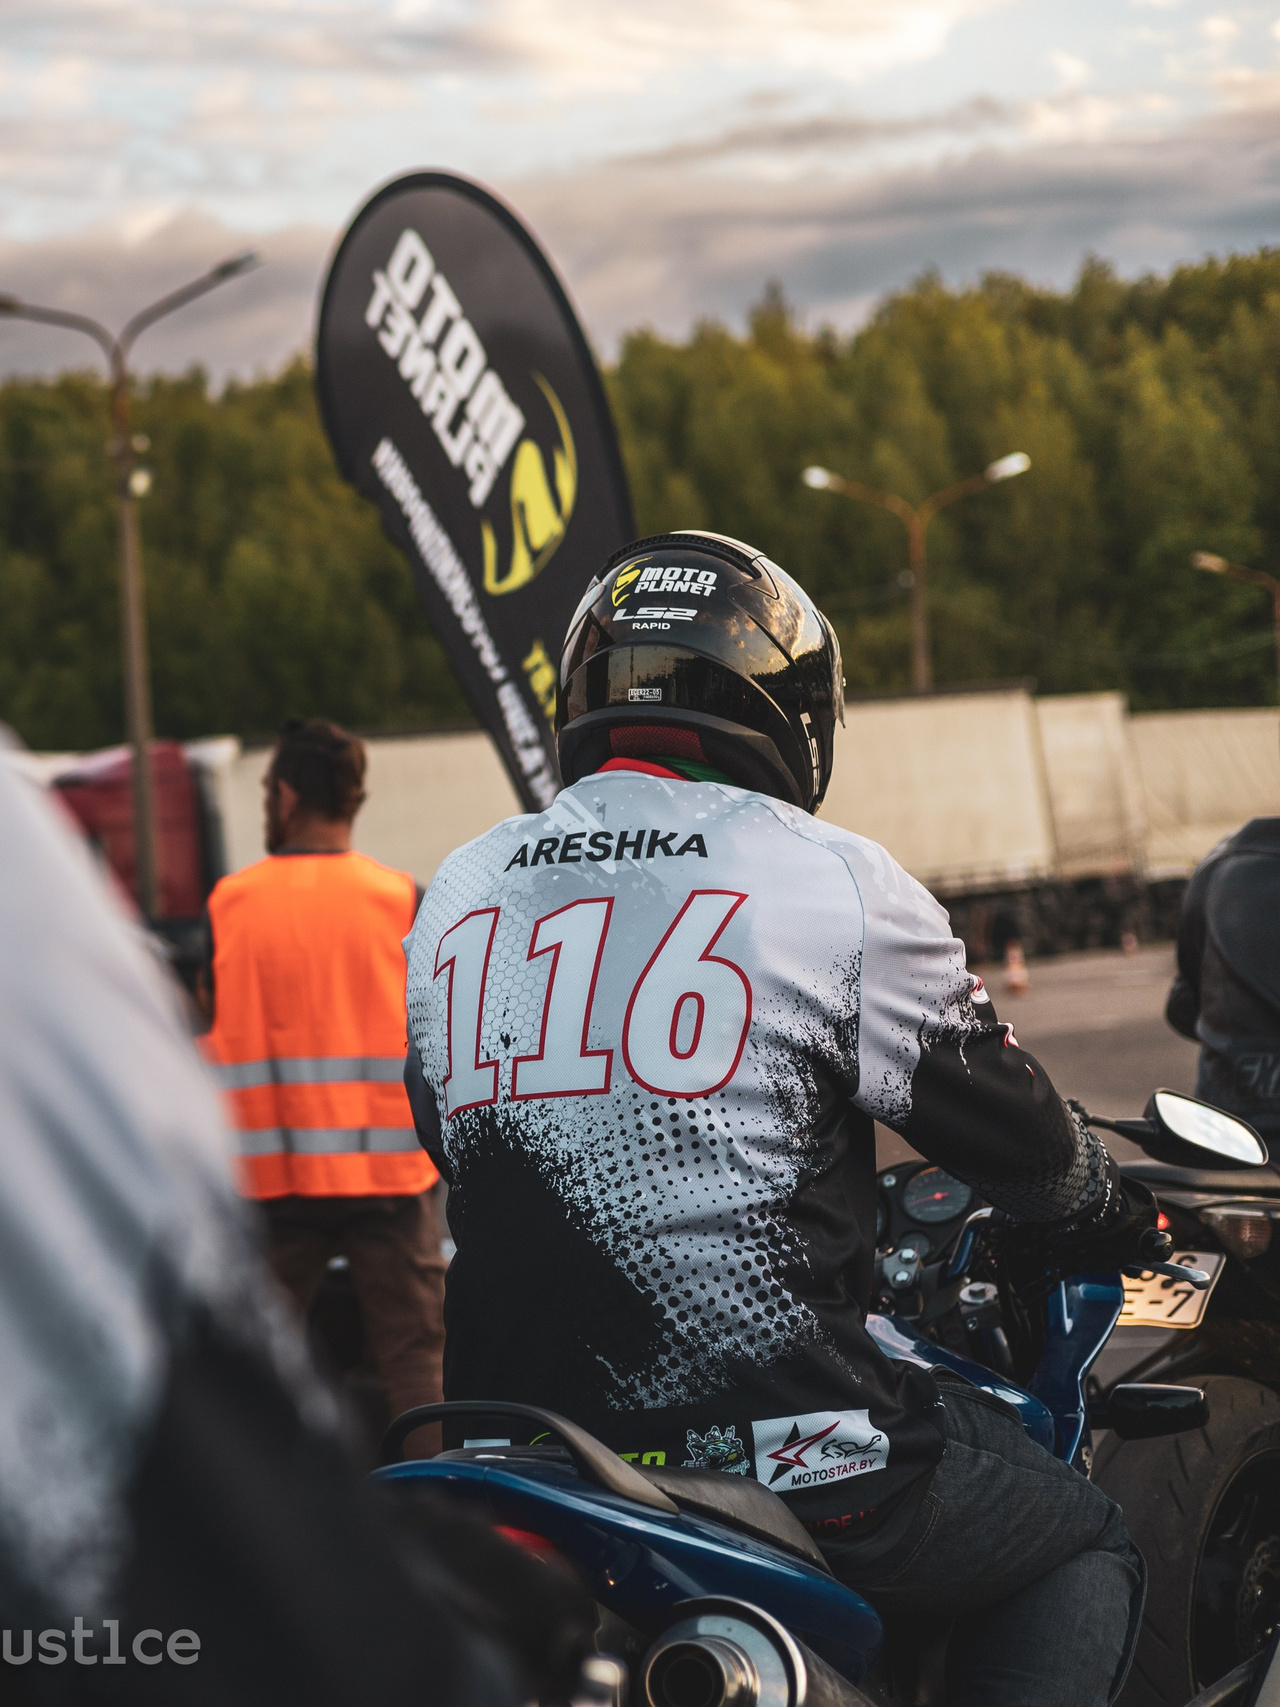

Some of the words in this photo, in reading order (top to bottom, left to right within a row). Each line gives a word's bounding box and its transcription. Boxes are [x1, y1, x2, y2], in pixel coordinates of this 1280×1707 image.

[639, 567, 717, 585] MOTO
[634, 581, 717, 597] PLANET
[612, 607, 698, 621] LS2
[632, 622, 671, 630] RAPID
[504, 829, 708, 873] ARESHKA
[433, 889, 753, 1121] 116
[791, 1458, 877, 1486] MOTOSTAR.BY
